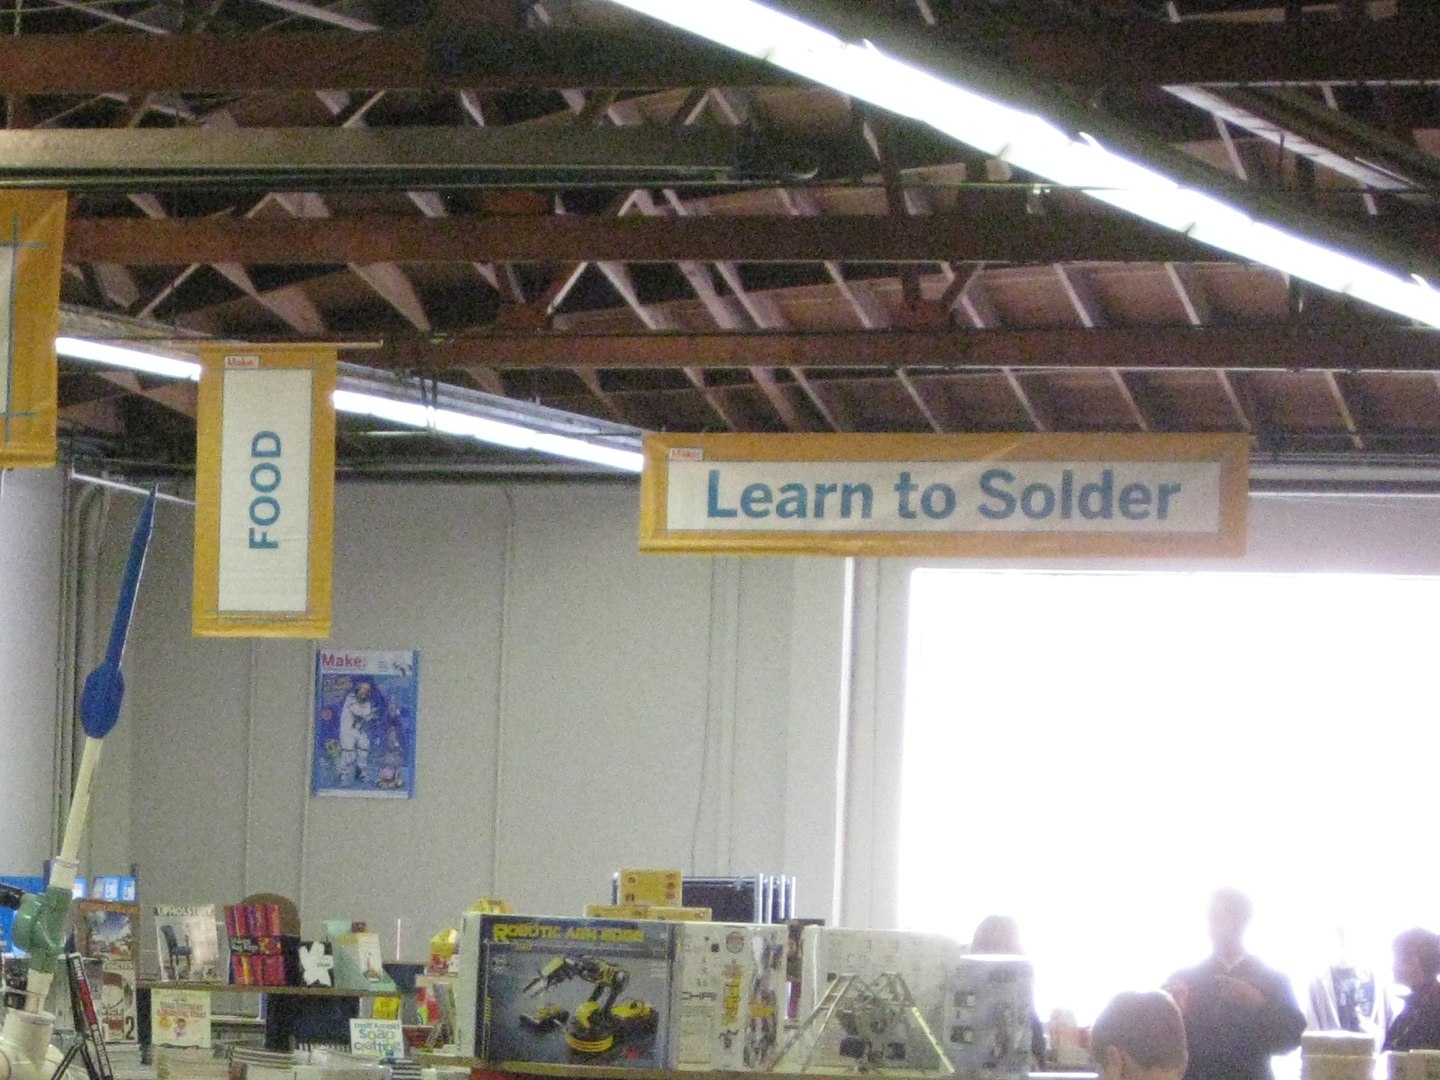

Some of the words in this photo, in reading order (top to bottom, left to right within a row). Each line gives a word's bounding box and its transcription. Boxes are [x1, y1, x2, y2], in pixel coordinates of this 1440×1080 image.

[248, 430, 282, 549] FOOD
[707, 469, 873, 519] Learn
[895, 471, 957, 519] to
[978, 468, 1181, 519] Solder
[493, 923, 561, 944] ROBOTIC
